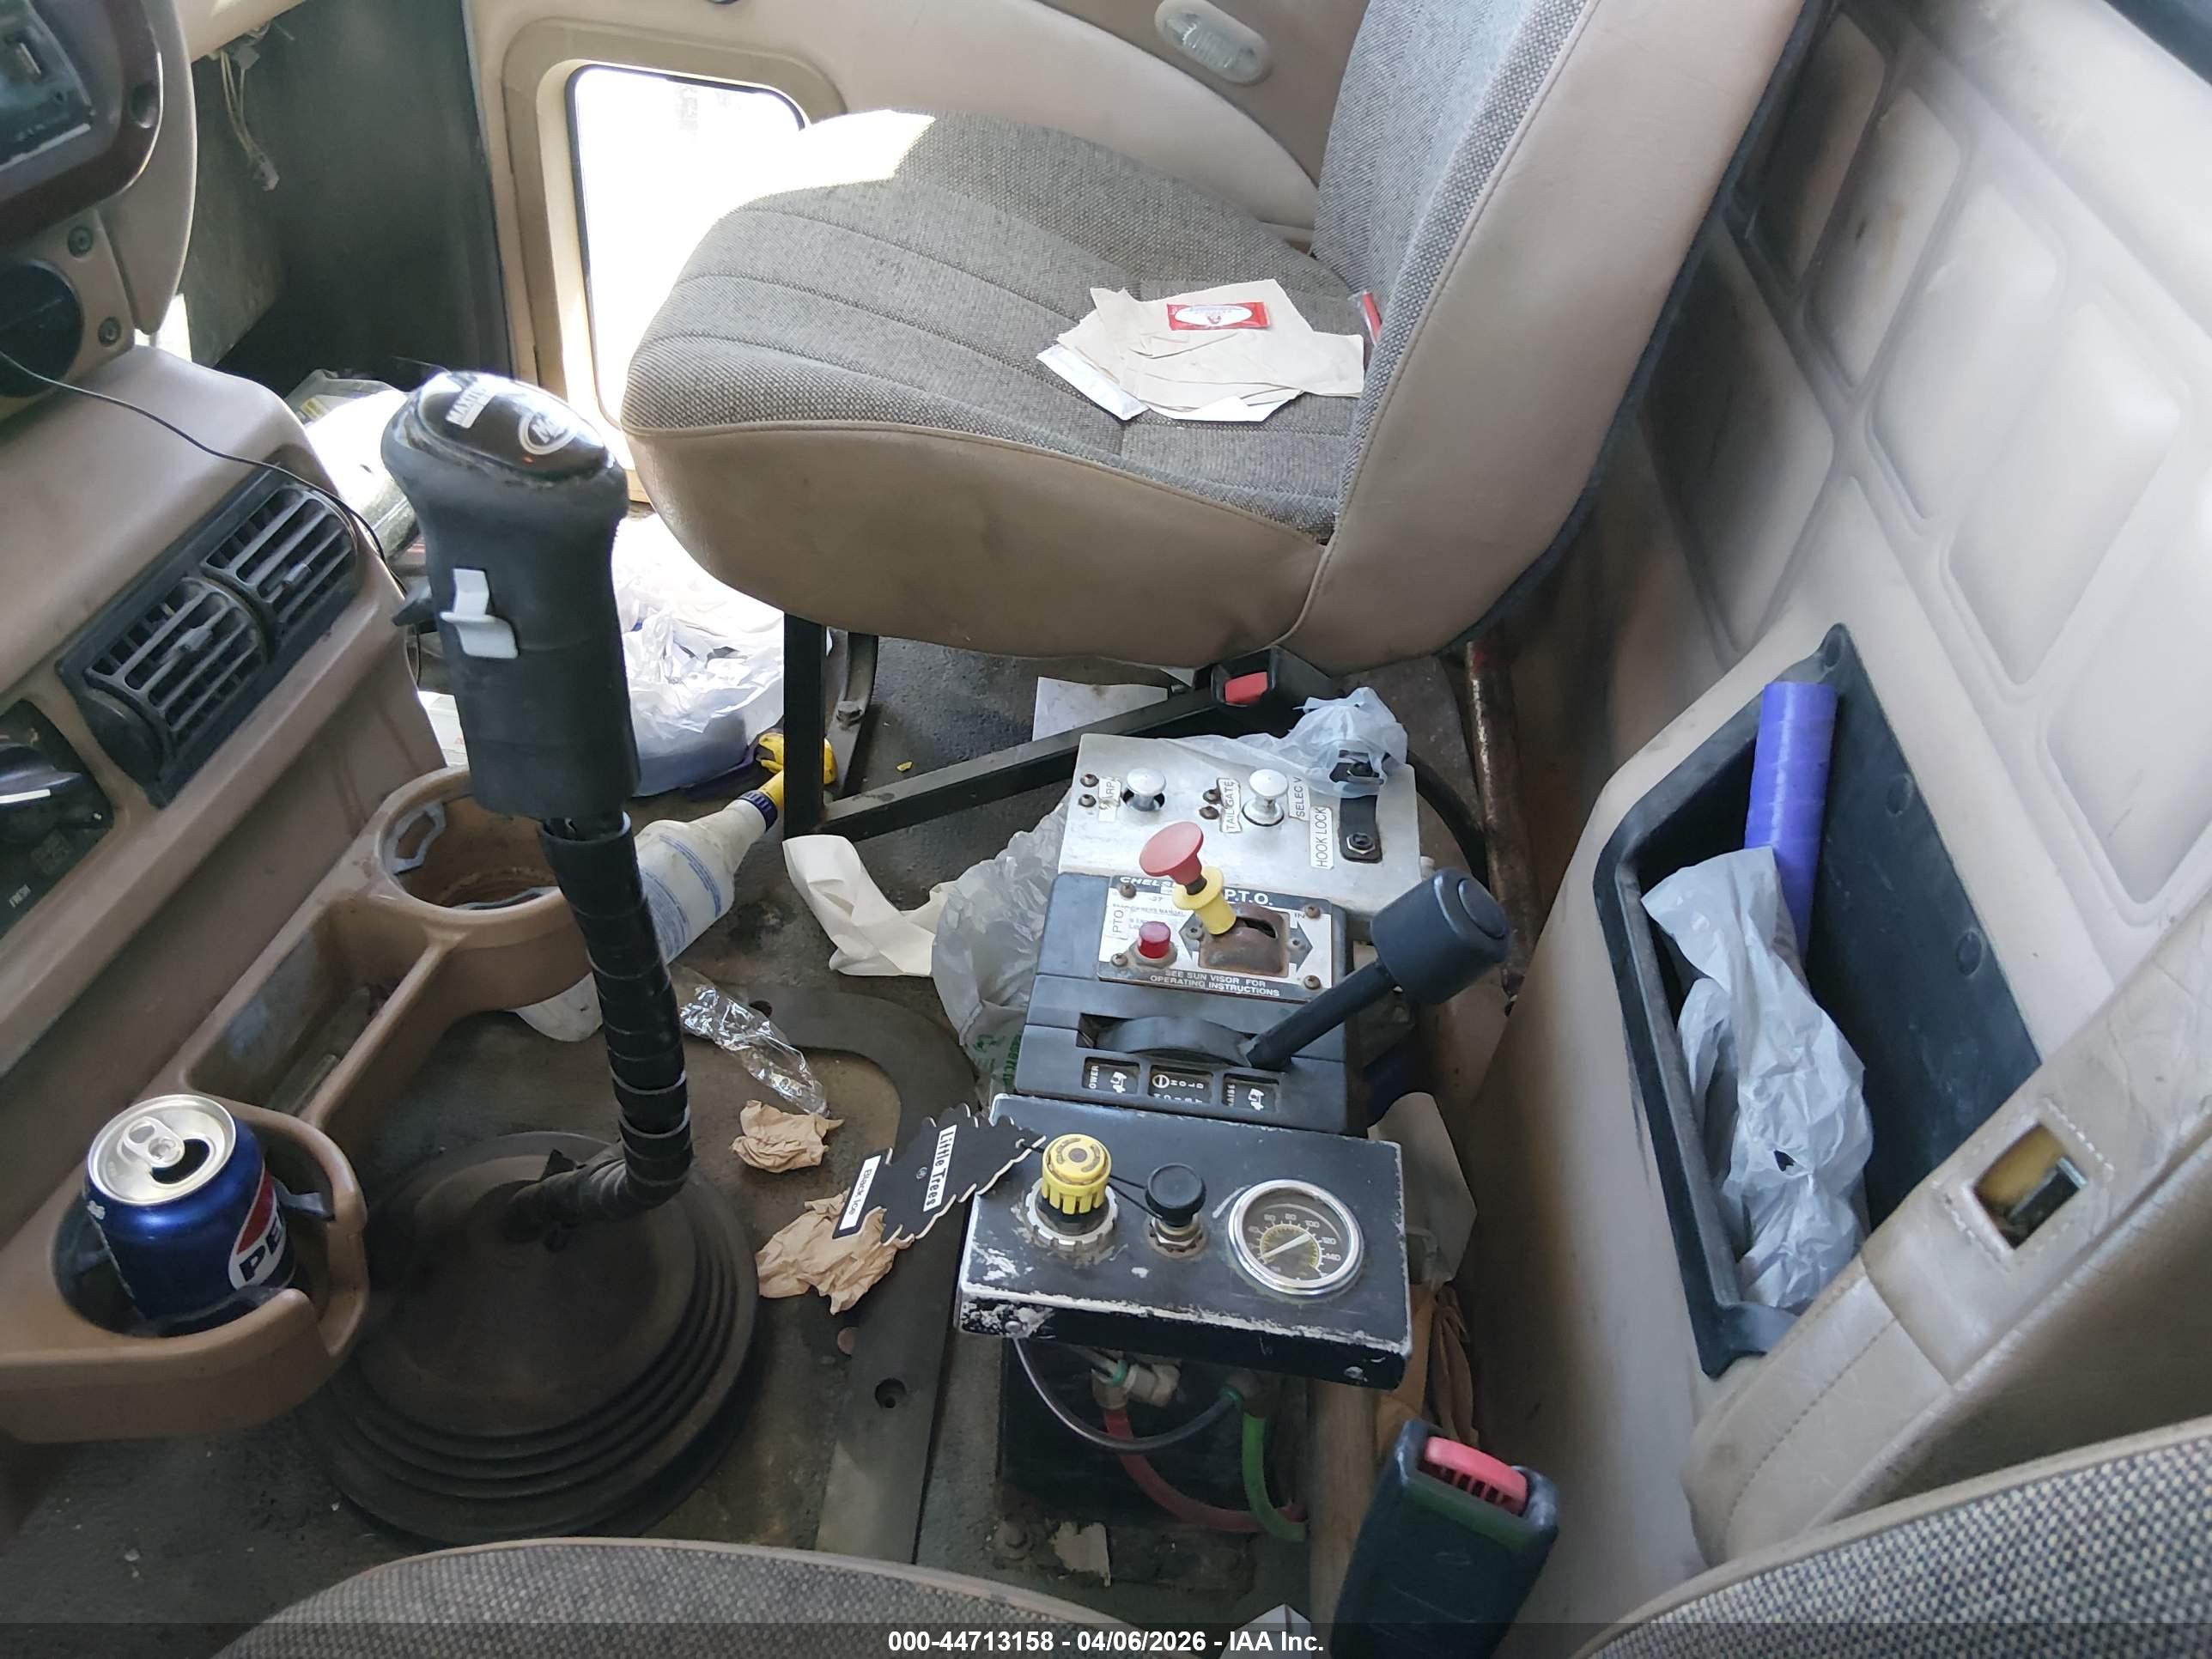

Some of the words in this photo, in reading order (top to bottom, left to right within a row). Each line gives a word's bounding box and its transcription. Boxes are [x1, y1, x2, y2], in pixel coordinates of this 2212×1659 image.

[1314, 806, 1328, 836] LOCK
[1315, 837, 1328, 868] HOOK
[1112, 909, 1124, 933] PTO
[1150, 975, 1206, 988] OPERATING
[1208, 981, 1280, 997] INSTRUCTIONS
[1164, 969, 1184, 979] SEE
[1186, 972, 1207, 981] SUN
[1210, 975, 1240, 985] VISOR
[1245, 977, 1267, 988] FOR
[1088, 1065, 1100, 1089] OWER
[933, 1131, 955, 1167] Little
[857, 1168, 872, 1195] Black
[926, 1167, 947, 1206] Trees
[848, 1196, 862, 1216] Ice
